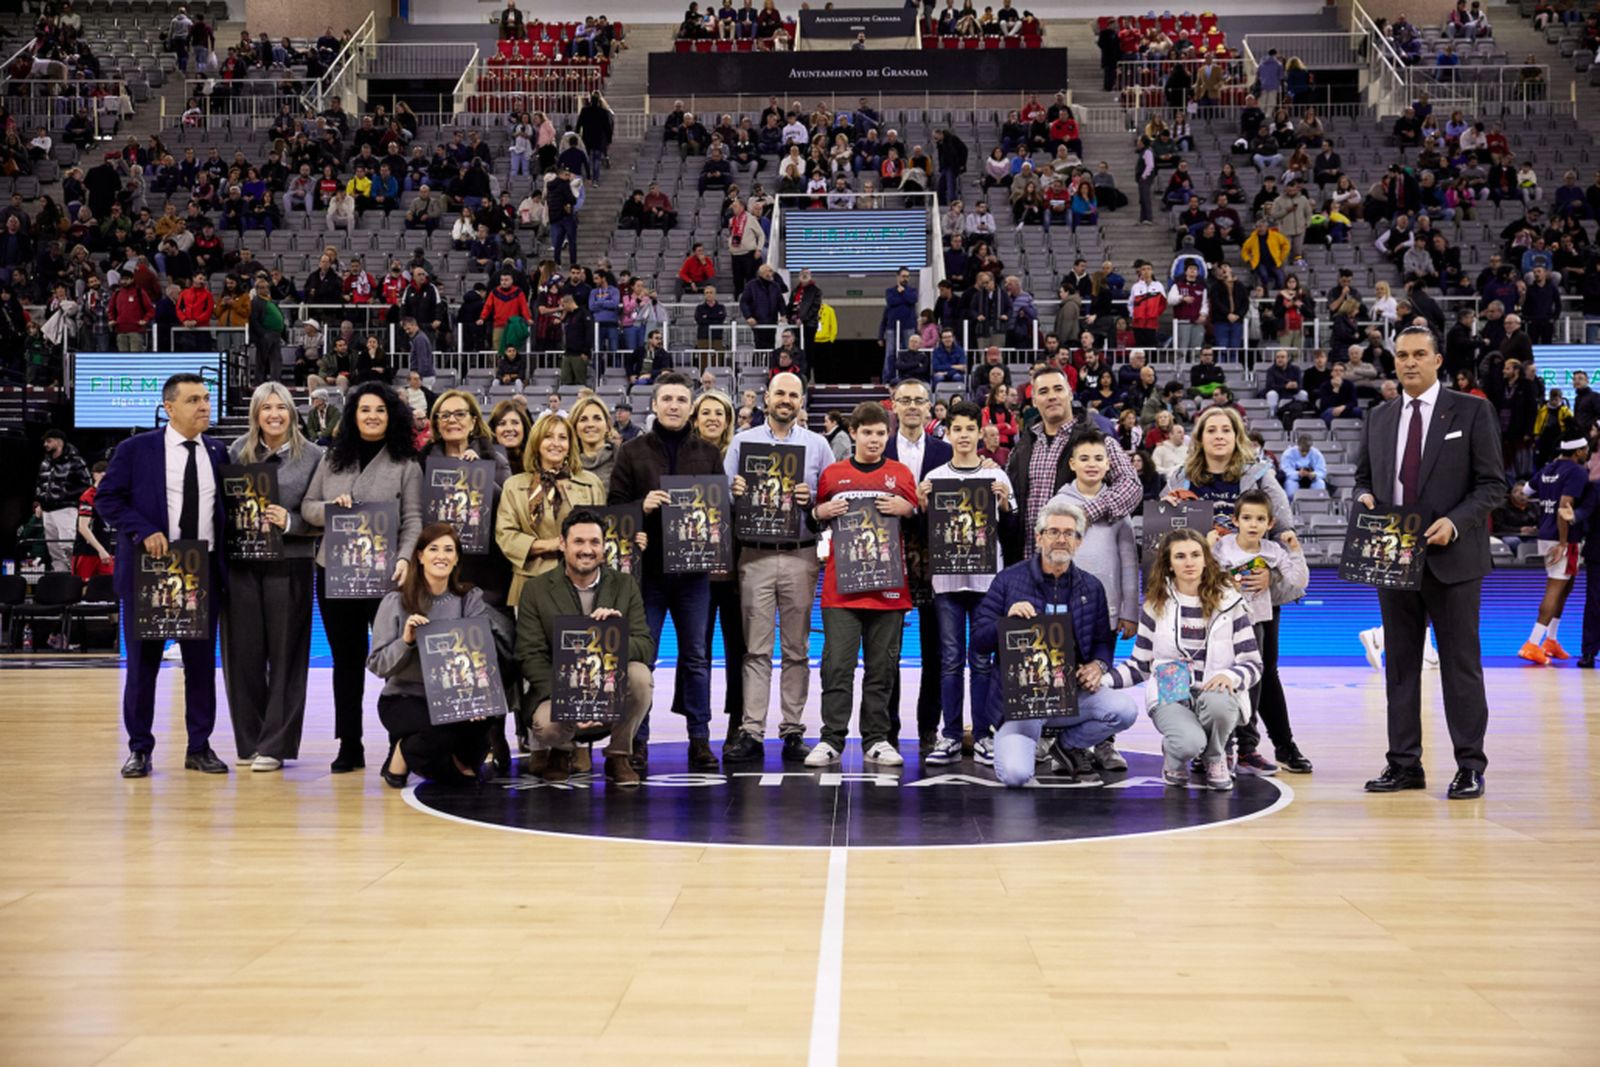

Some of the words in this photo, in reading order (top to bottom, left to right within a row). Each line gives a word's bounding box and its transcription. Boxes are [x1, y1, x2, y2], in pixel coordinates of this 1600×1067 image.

[789, 68, 863, 78] AYUNTAMIENTO
[866, 69, 879, 77] DE
[881, 67, 929, 77] GRANADA
